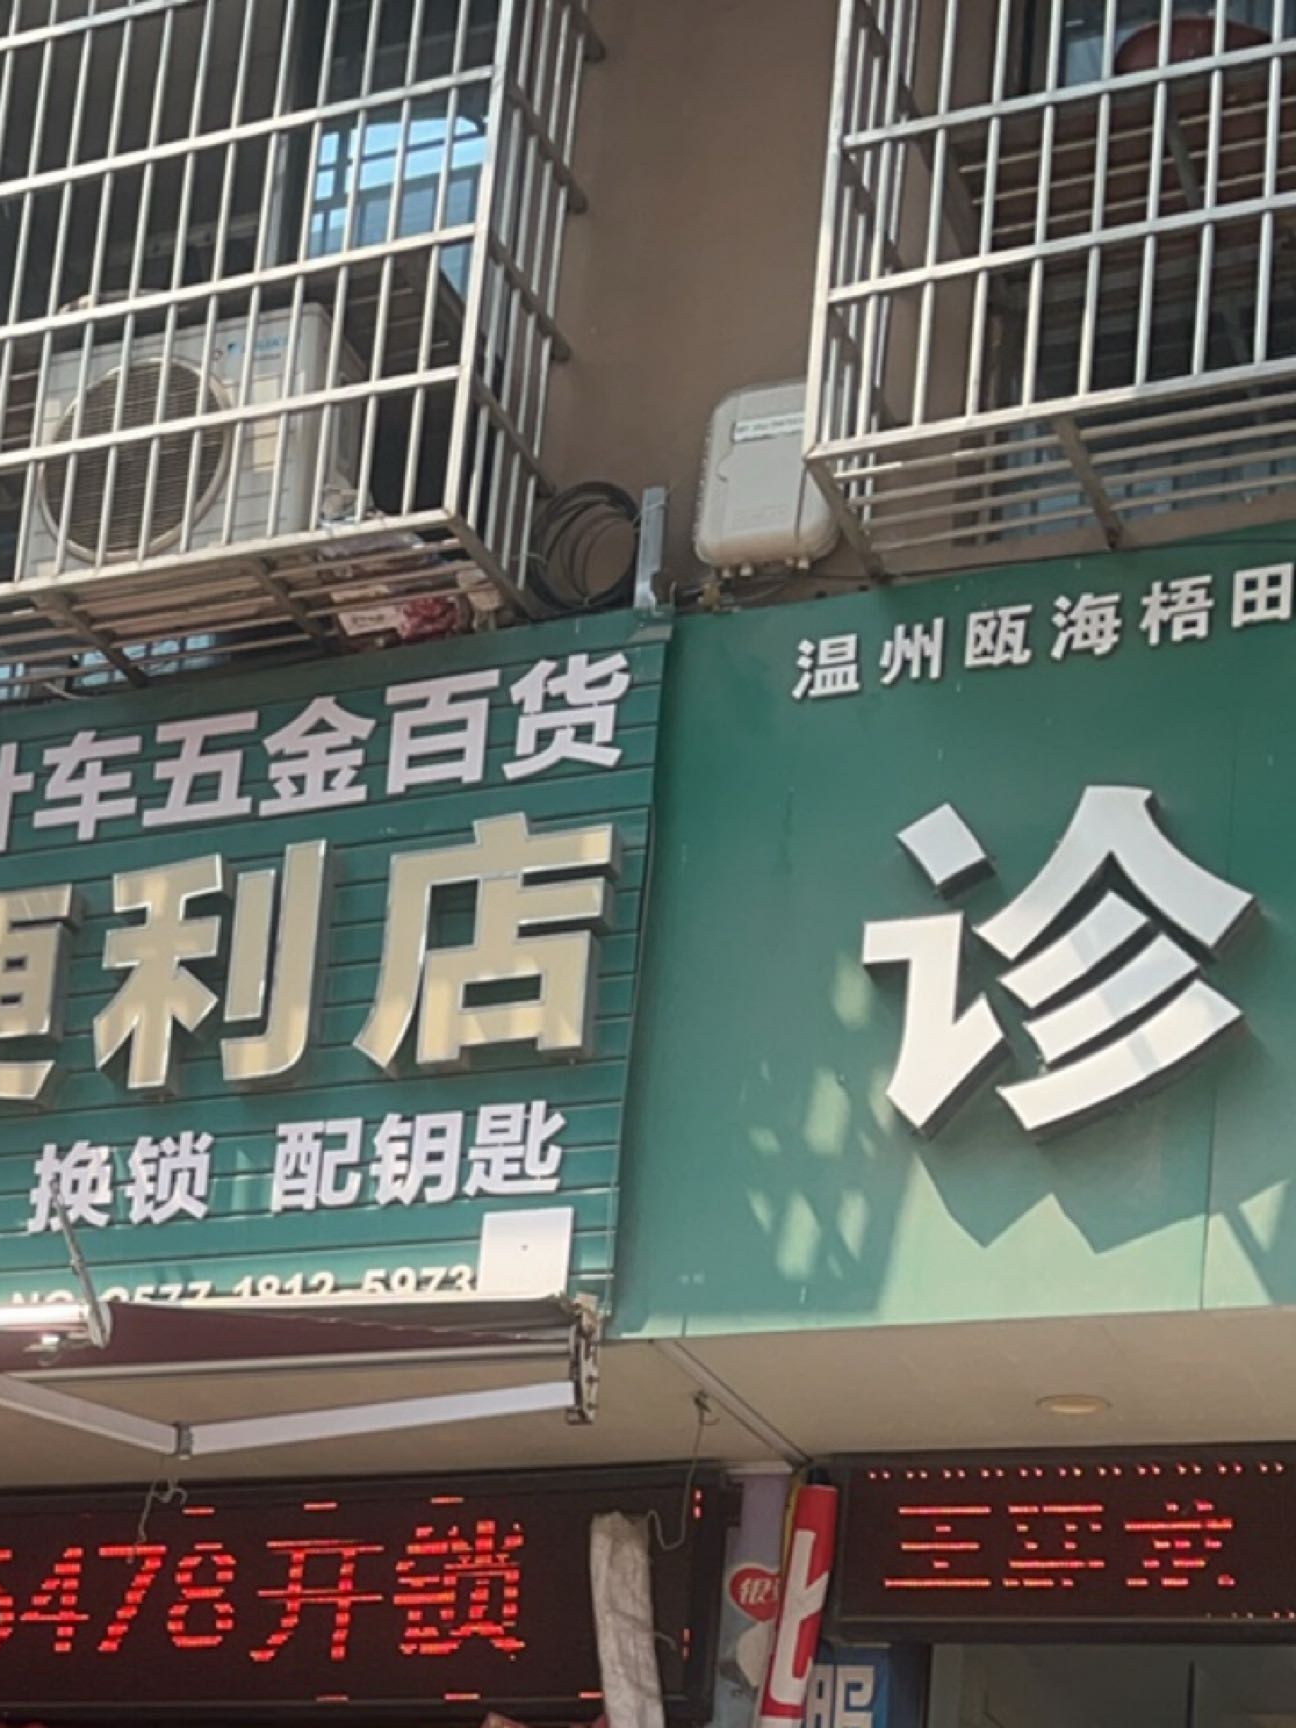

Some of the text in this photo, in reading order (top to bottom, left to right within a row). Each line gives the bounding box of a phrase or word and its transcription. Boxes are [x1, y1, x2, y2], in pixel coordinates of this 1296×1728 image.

[792, 560, 1296, 701] 温州瓯海梧田
[862, 785, 1256, 1136] 诊
[28, 1130, 215, 1241] 换锁
[271, 1102, 567, 1211] 配钥匙
